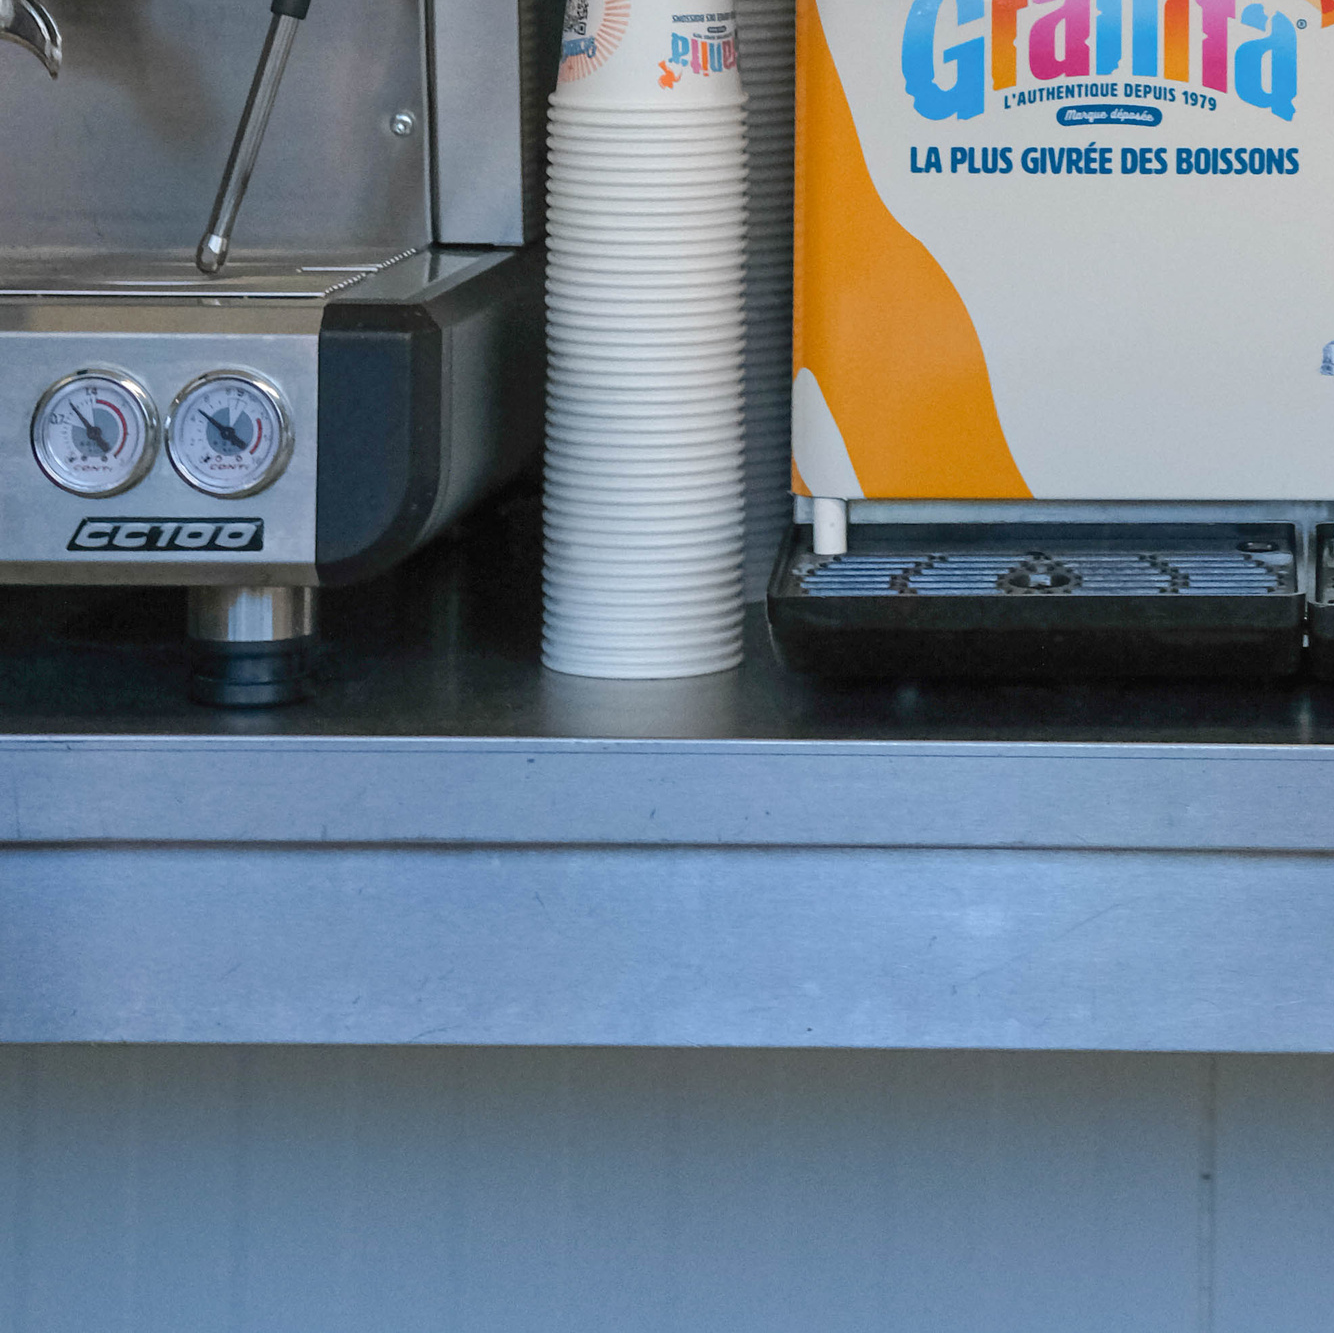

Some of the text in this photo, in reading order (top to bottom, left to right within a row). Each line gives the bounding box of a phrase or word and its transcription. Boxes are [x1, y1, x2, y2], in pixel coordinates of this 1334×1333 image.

[1004, 83, 1217, 111] L'AUTHENTIQUE DEPUIS 1979
[910, 142, 1300, 175] LA PLUS GIVRÉE DES BOISSONS
